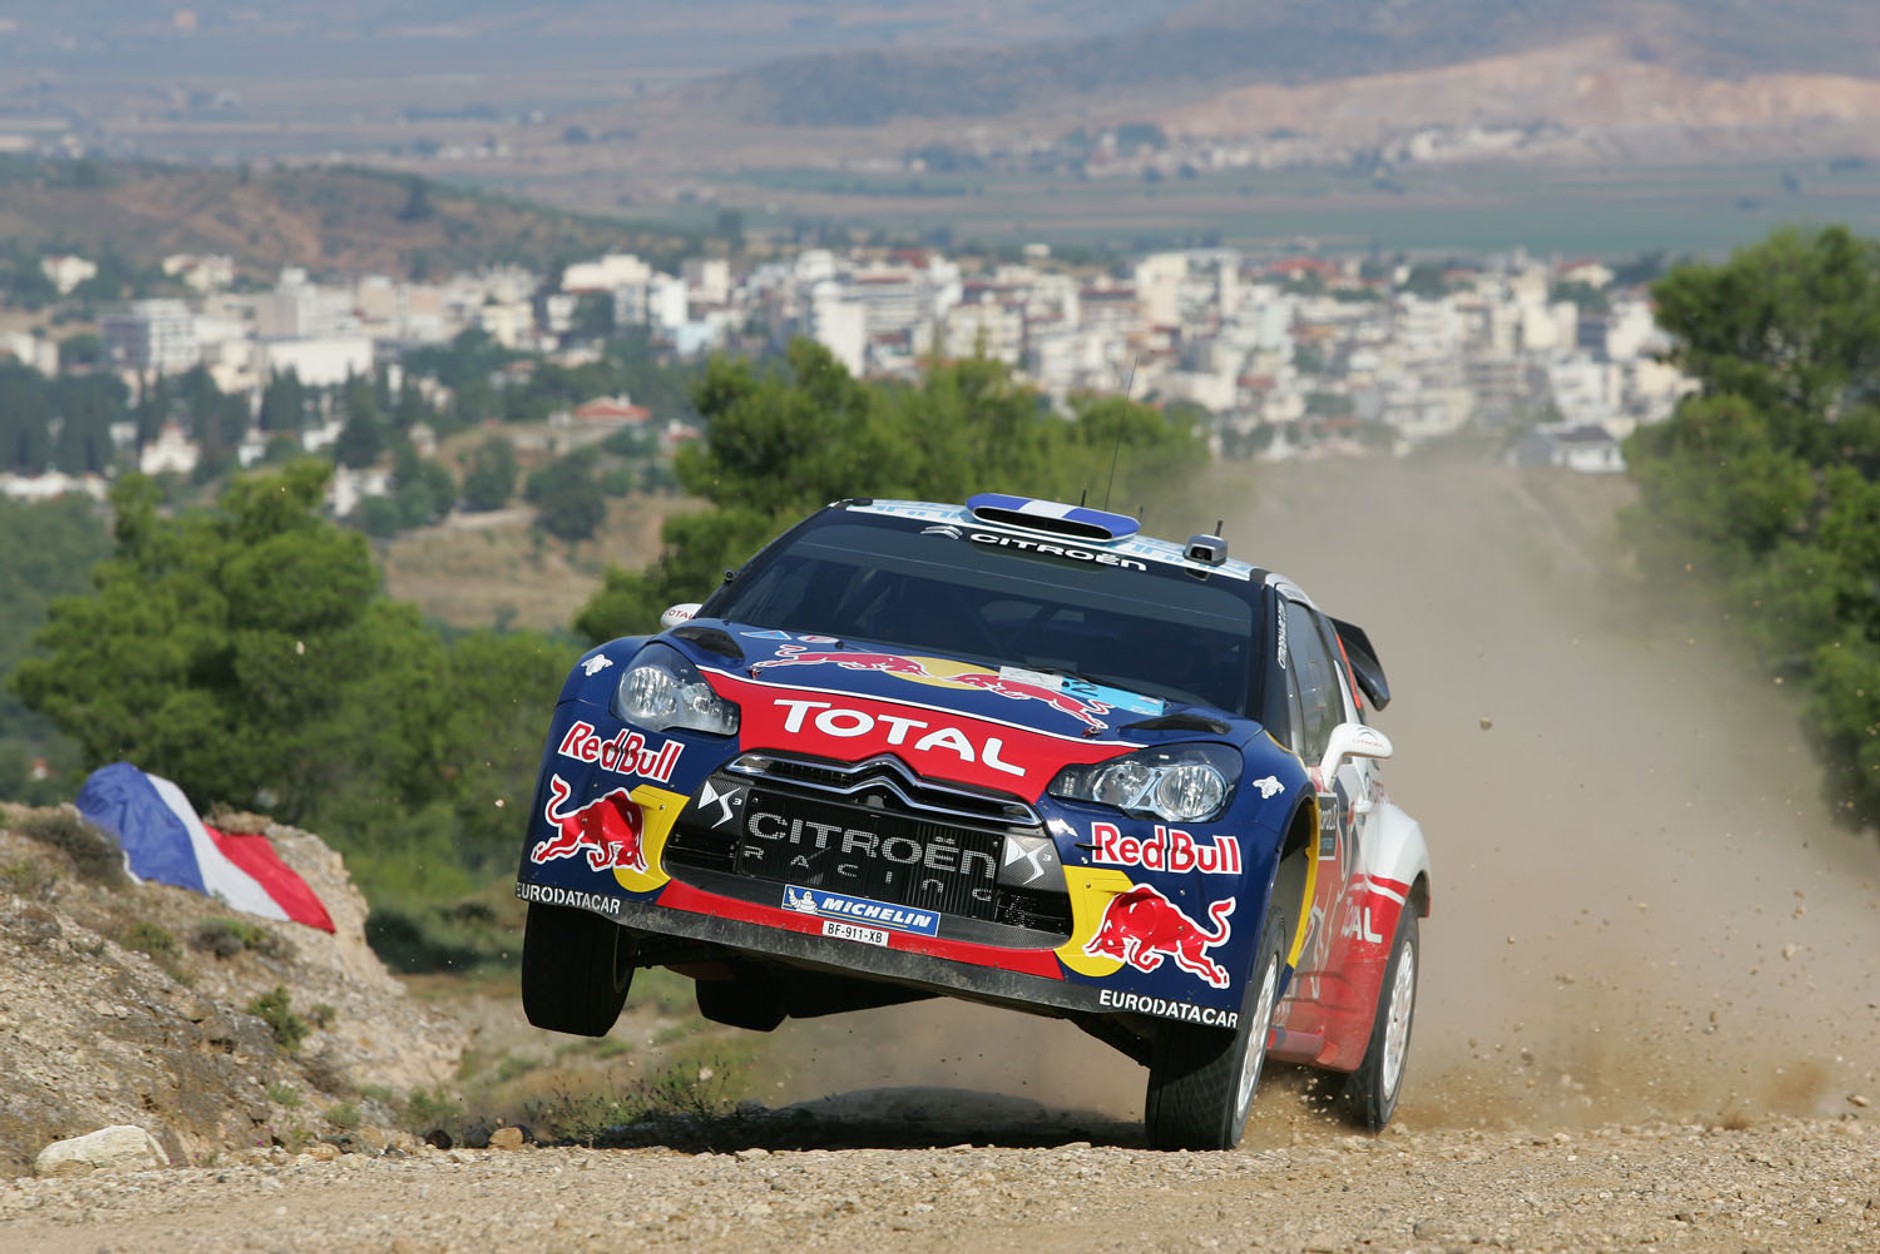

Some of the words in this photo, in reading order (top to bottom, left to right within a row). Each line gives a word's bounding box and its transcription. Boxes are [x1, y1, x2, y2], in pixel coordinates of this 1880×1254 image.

[970, 532, 1147, 572] CITROËN
[773, 698, 1026, 776] TOTAL
[748, 812, 997, 878] CITROËN
[517, 883, 621, 914] EURODATACAR
[821, 897, 933, 928] MICHELIN
[827, 922, 884, 944] BF-911-XB
[1099, 989, 1239, 1028] EURODATACAR
